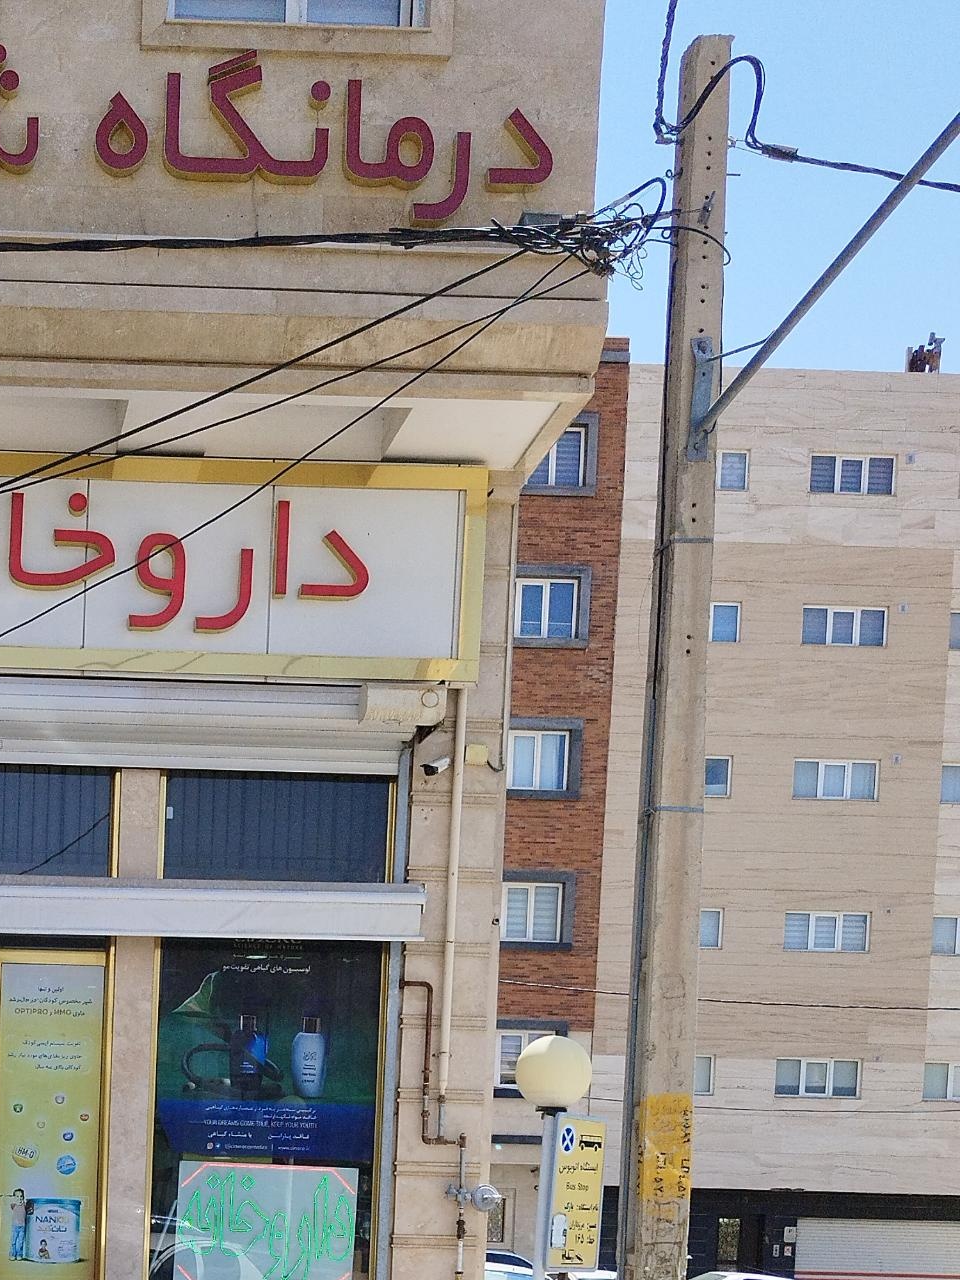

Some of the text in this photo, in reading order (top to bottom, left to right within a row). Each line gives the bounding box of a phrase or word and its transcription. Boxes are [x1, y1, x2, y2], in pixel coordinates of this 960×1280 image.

[96, 51, 554, 220] درمانگاه
[558, 1161, 599, 1174] ایستگاه اتوبوس
[566, 1181, 589, 1192] Bus Stop
